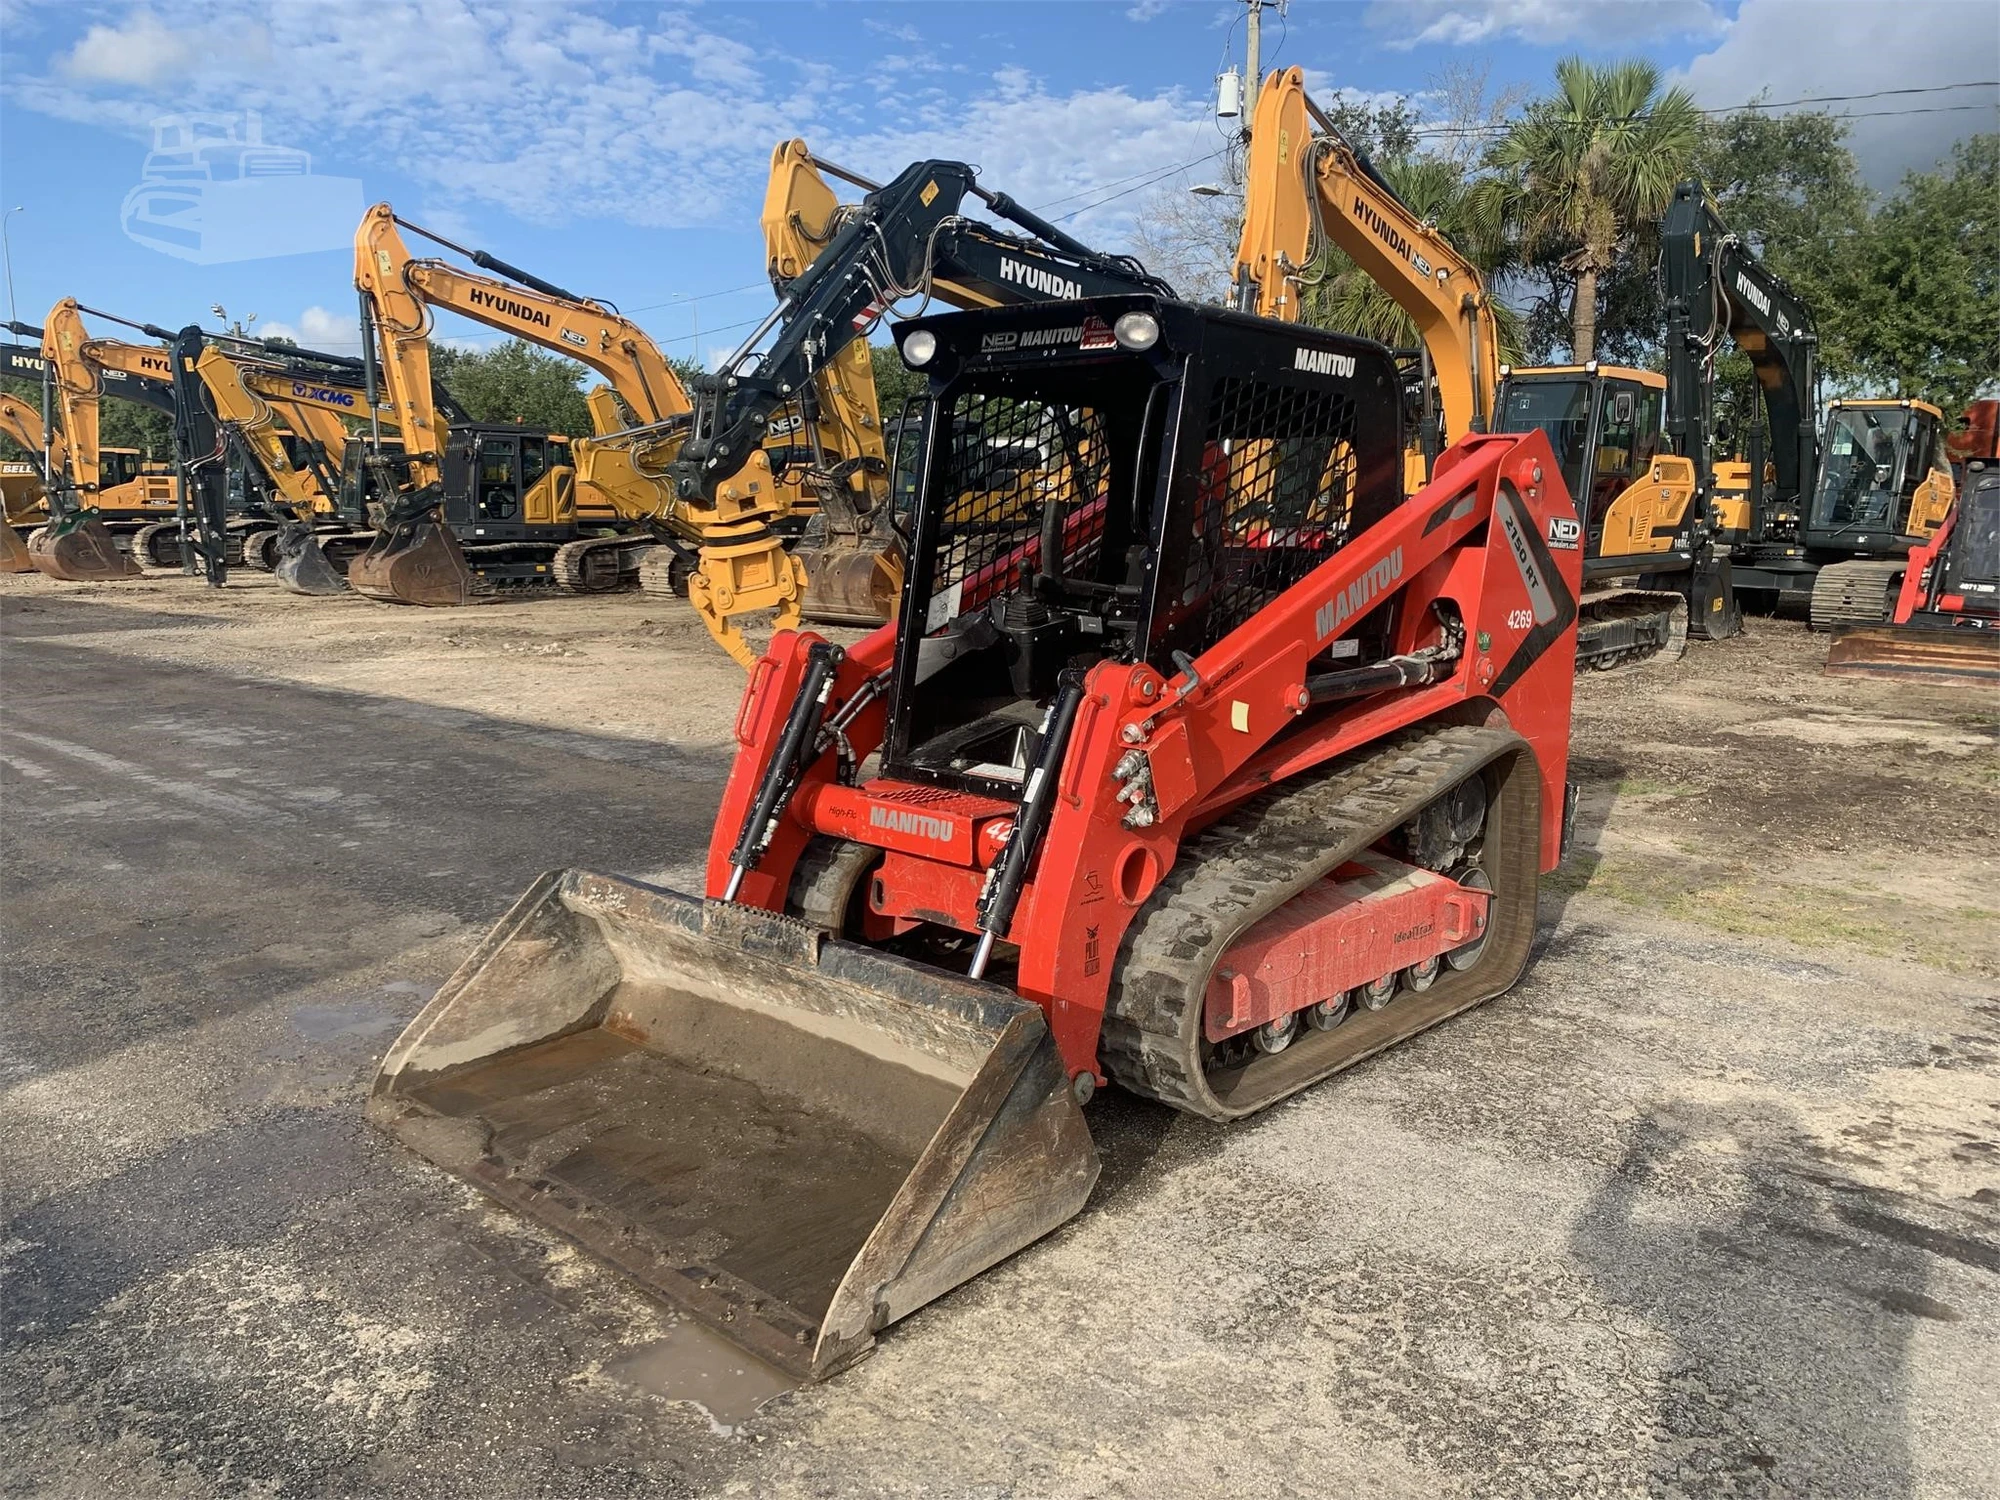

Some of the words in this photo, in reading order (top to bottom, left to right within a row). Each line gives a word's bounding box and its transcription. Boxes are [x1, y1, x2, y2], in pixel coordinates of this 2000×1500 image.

[1353, 196, 1411, 262] HYUNDAI
[1412, 251, 1432, 277] NED
[1000, 256, 1082, 300] HYUNDAI
[1736, 271, 1771, 317] HYUNDAI
[470, 288, 551, 328] HYUNDAI
[1776, 309, 1789, 333] NED
[561, 327, 589, 346] NED
[981, 332, 1018, 347] NED
[1020, 327, 1084, 347] MANITOU
[102, 369, 127, 378] NED
[1294, 347, 1356, 379] MANITOU
[308, 388, 355, 407] XCMG
[769, 415, 803, 434] NED
[3, 464, 33, 474] BELL
[1549, 518, 1581, 540] NED
[1505, 515, 1528, 565] 2150
[1525, 565, 1539, 589] RT
[1315, 545, 1403, 642] MANITOU
[1507, 609, 1532, 630] 4269
[870, 806, 954, 842] MANITOU
